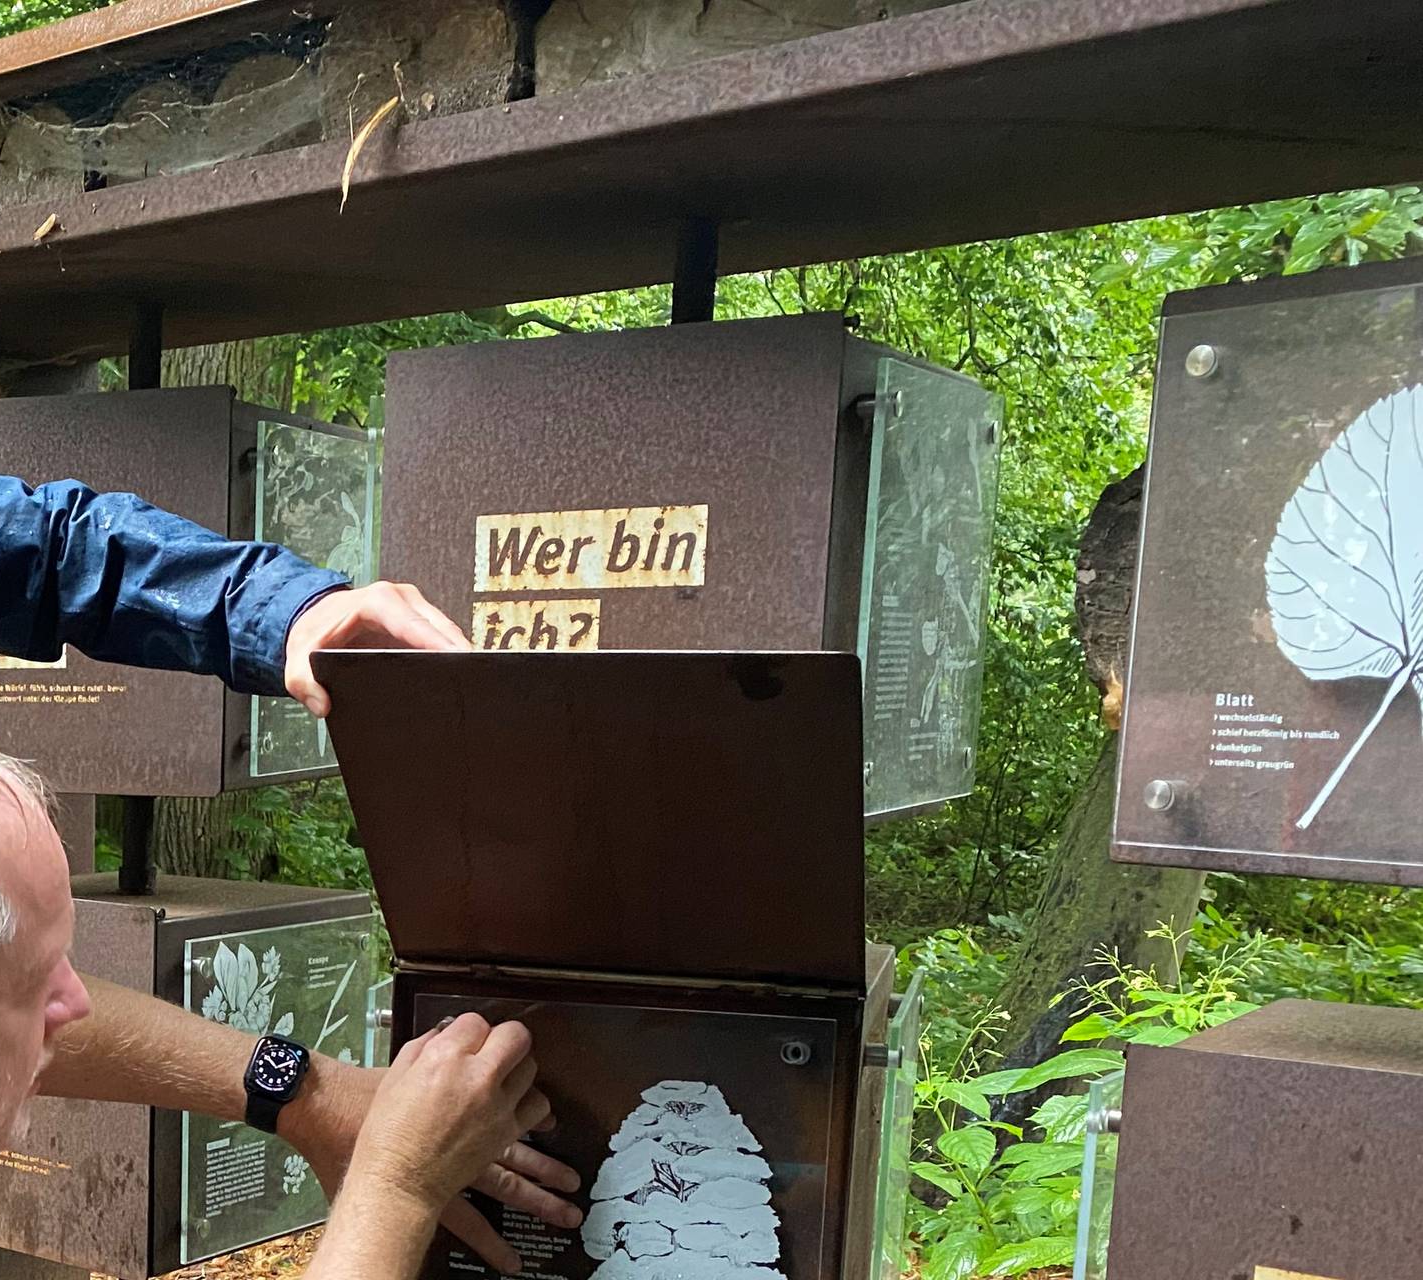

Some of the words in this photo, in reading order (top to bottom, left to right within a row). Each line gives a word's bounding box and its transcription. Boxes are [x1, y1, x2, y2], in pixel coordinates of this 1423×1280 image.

[488, 526, 596, 577] Wer
[605, 517, 698, 573] bin
[483, 609, 594, 650] ich?
[1215, 693, 1255, 707] Blatt
[1218, 713, 1283, 724] wechselständig
[1217, 728, 1242, 737] schief
[1289, 729, 1302, 738] bis
[1304, 730, 1340, 739] rundlich
[1216, 743, 1262, 754] dunkelgrün
[1214, 759, 1255, 768] unterseits
[1256, 760, 1295, 770] graugrün
